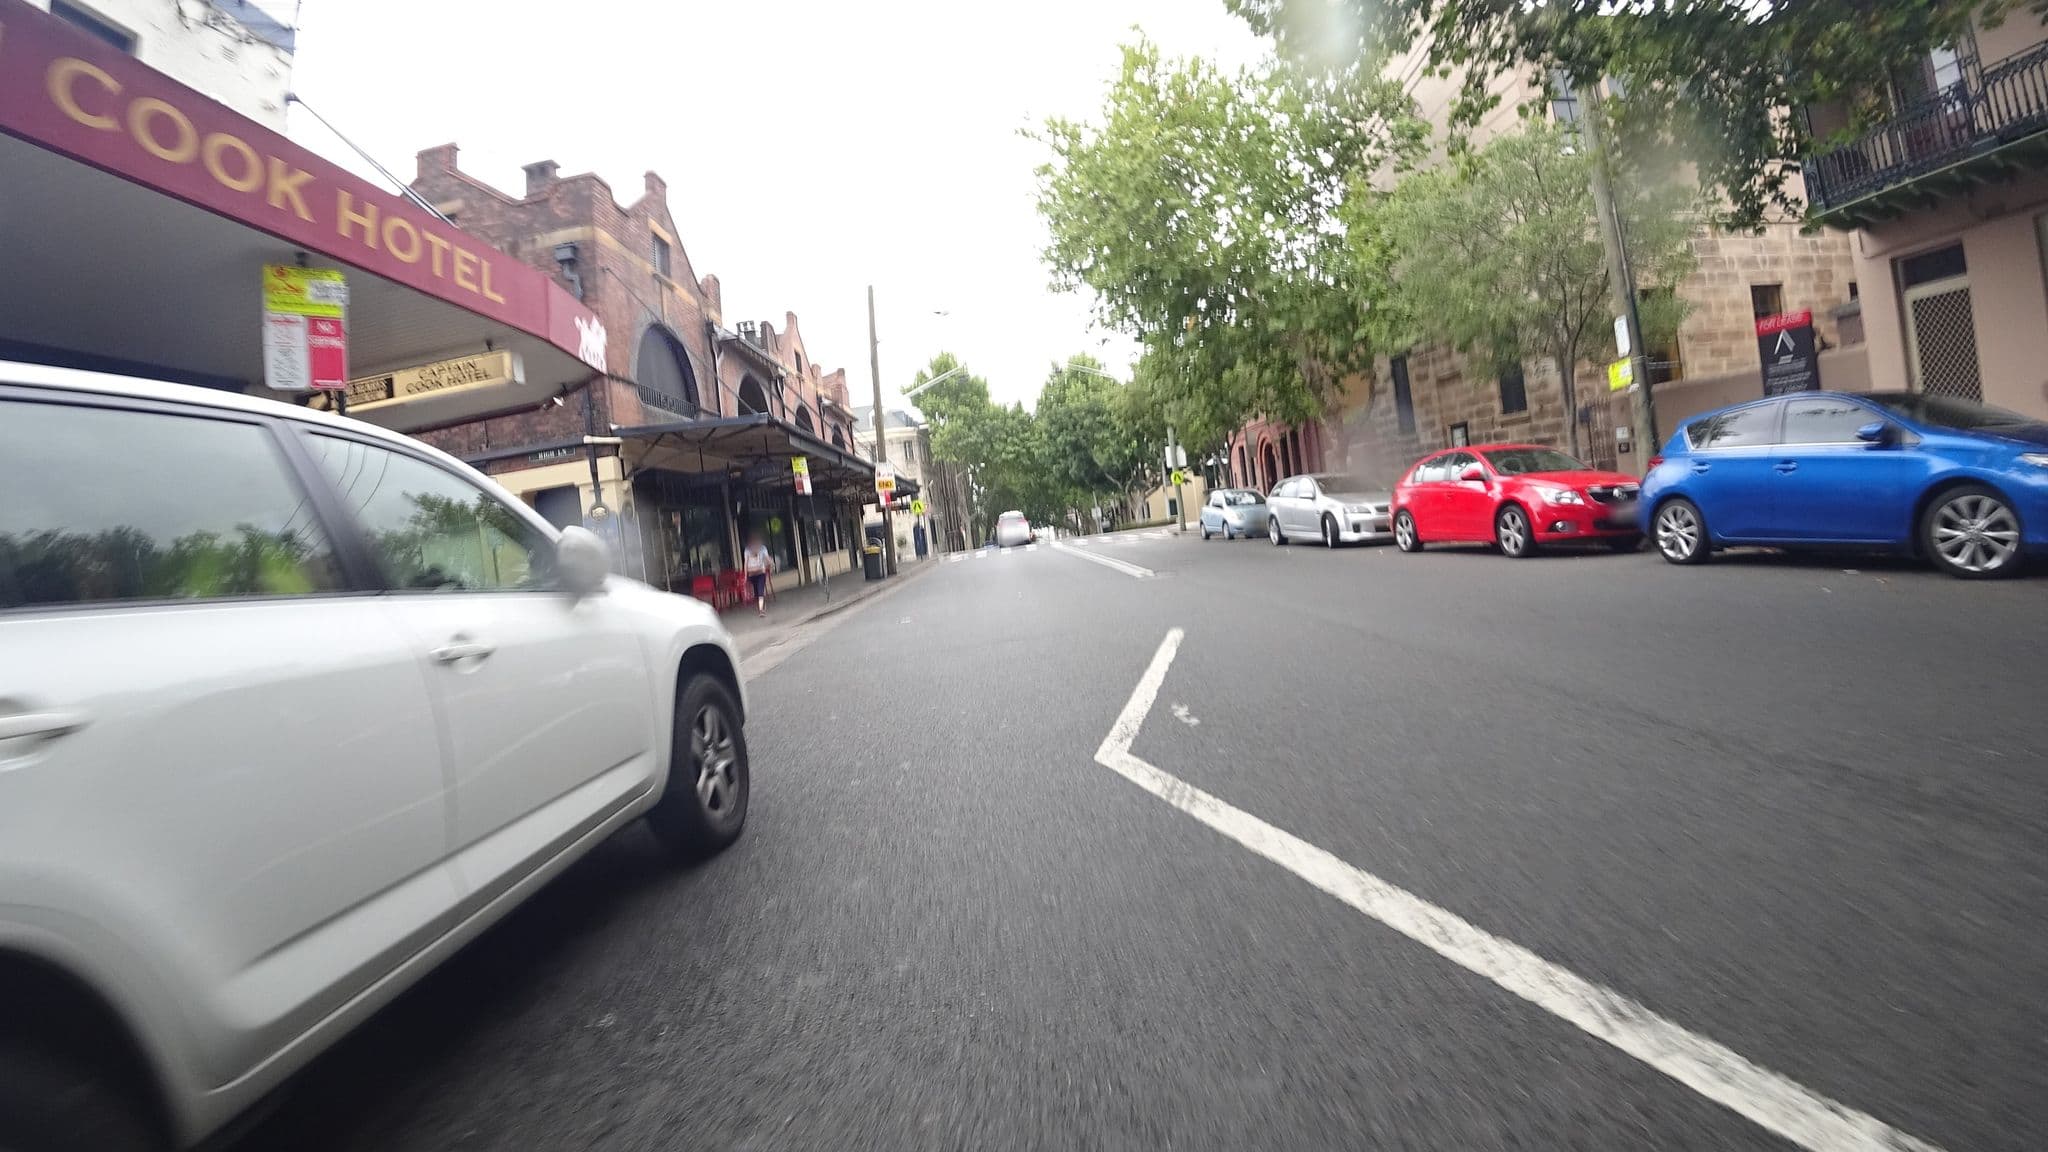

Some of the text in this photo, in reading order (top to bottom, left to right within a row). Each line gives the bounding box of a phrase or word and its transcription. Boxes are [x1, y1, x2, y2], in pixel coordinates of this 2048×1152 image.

[46, 56, 506, 304] COOK HOTEL
[405, 378, 443, 394] COOK
[447, 367, 492, 386] HOTEL
